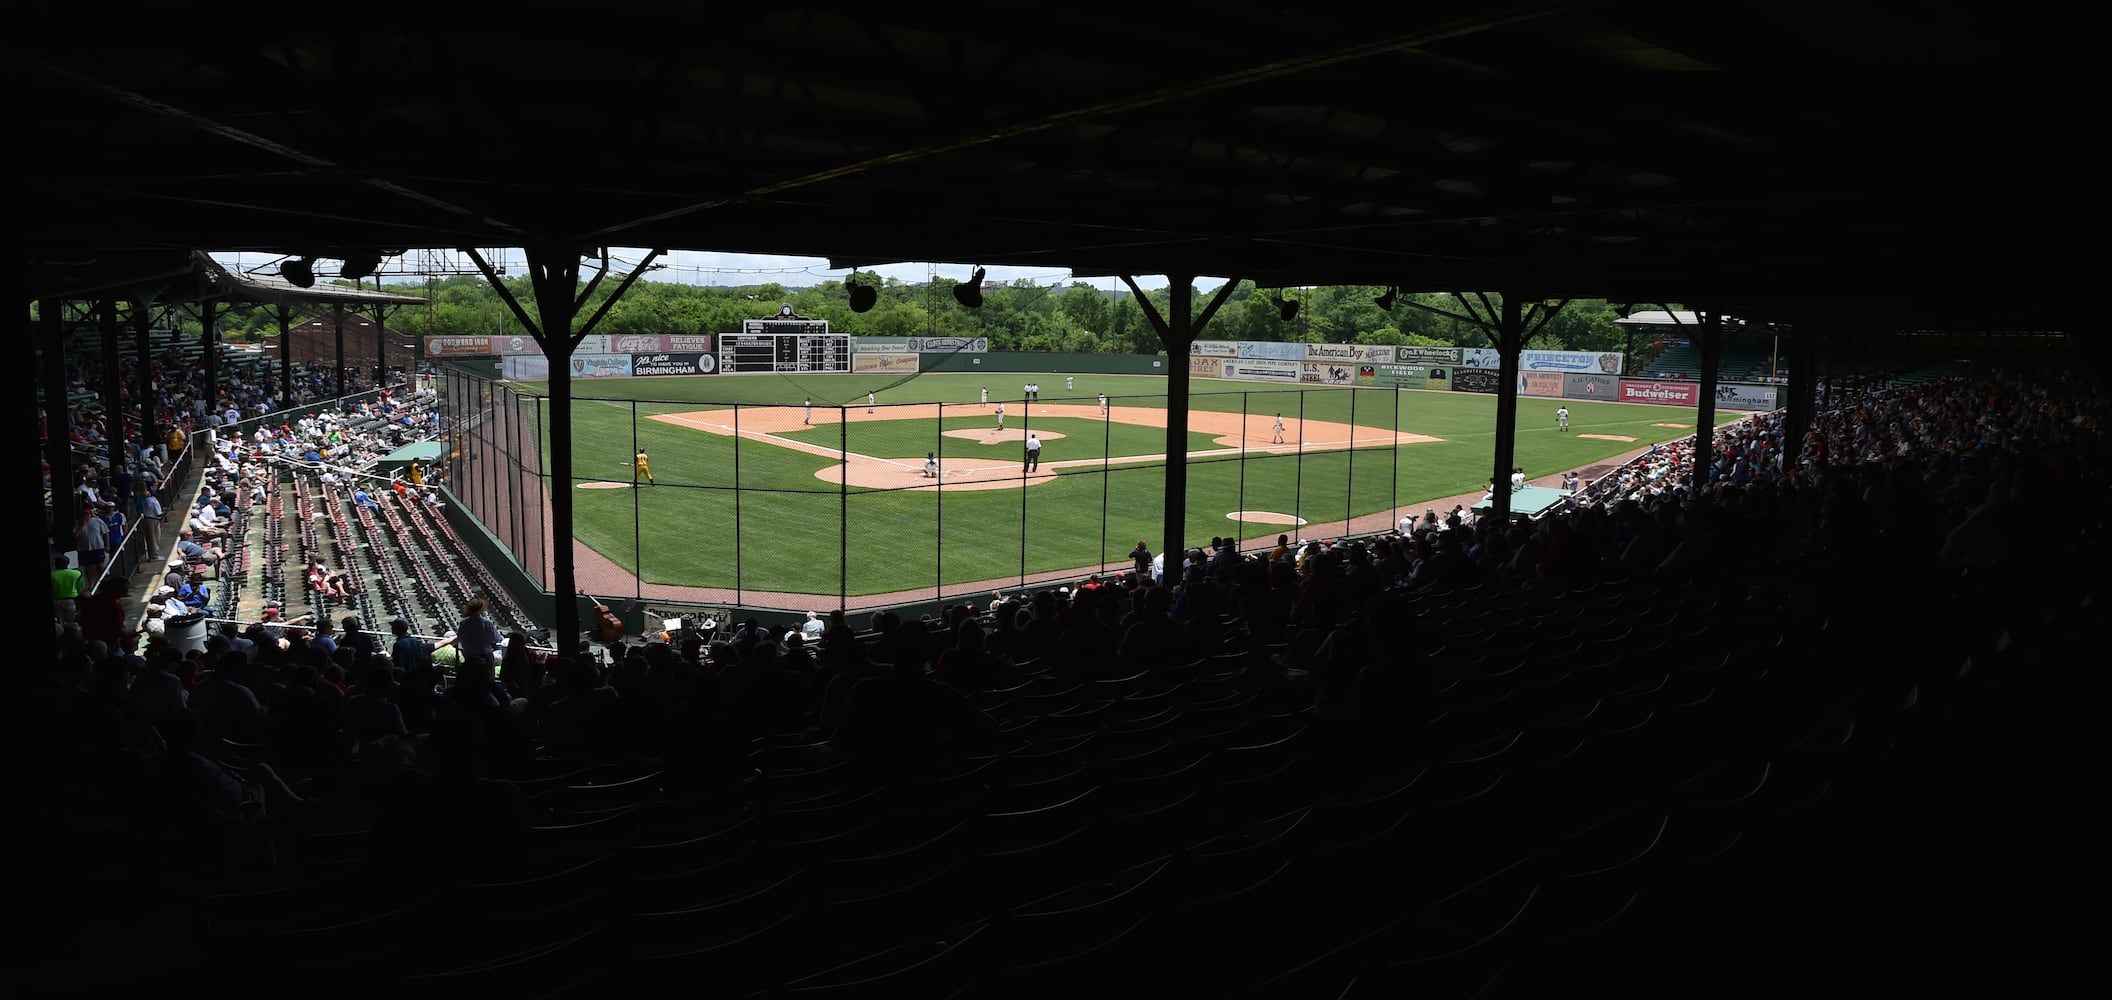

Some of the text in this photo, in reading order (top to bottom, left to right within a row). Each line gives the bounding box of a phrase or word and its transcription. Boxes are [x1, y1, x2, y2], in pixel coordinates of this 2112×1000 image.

[652, 353, 669, 362] nice
[1307, 345, 1319, 357] The
[1319, 345, 1349, 357] American
[1349, 346, 1363, 360] Boy
[1526, 353, 1595, 364] PRINCETON
[636, 366, 696, 375] BIRMINGHAM
[1303, 363, 1321, 373] U.S.
[1301, 373, 1322, 382] STEEL
[1625, 387, 1689, 400] Budweiser
